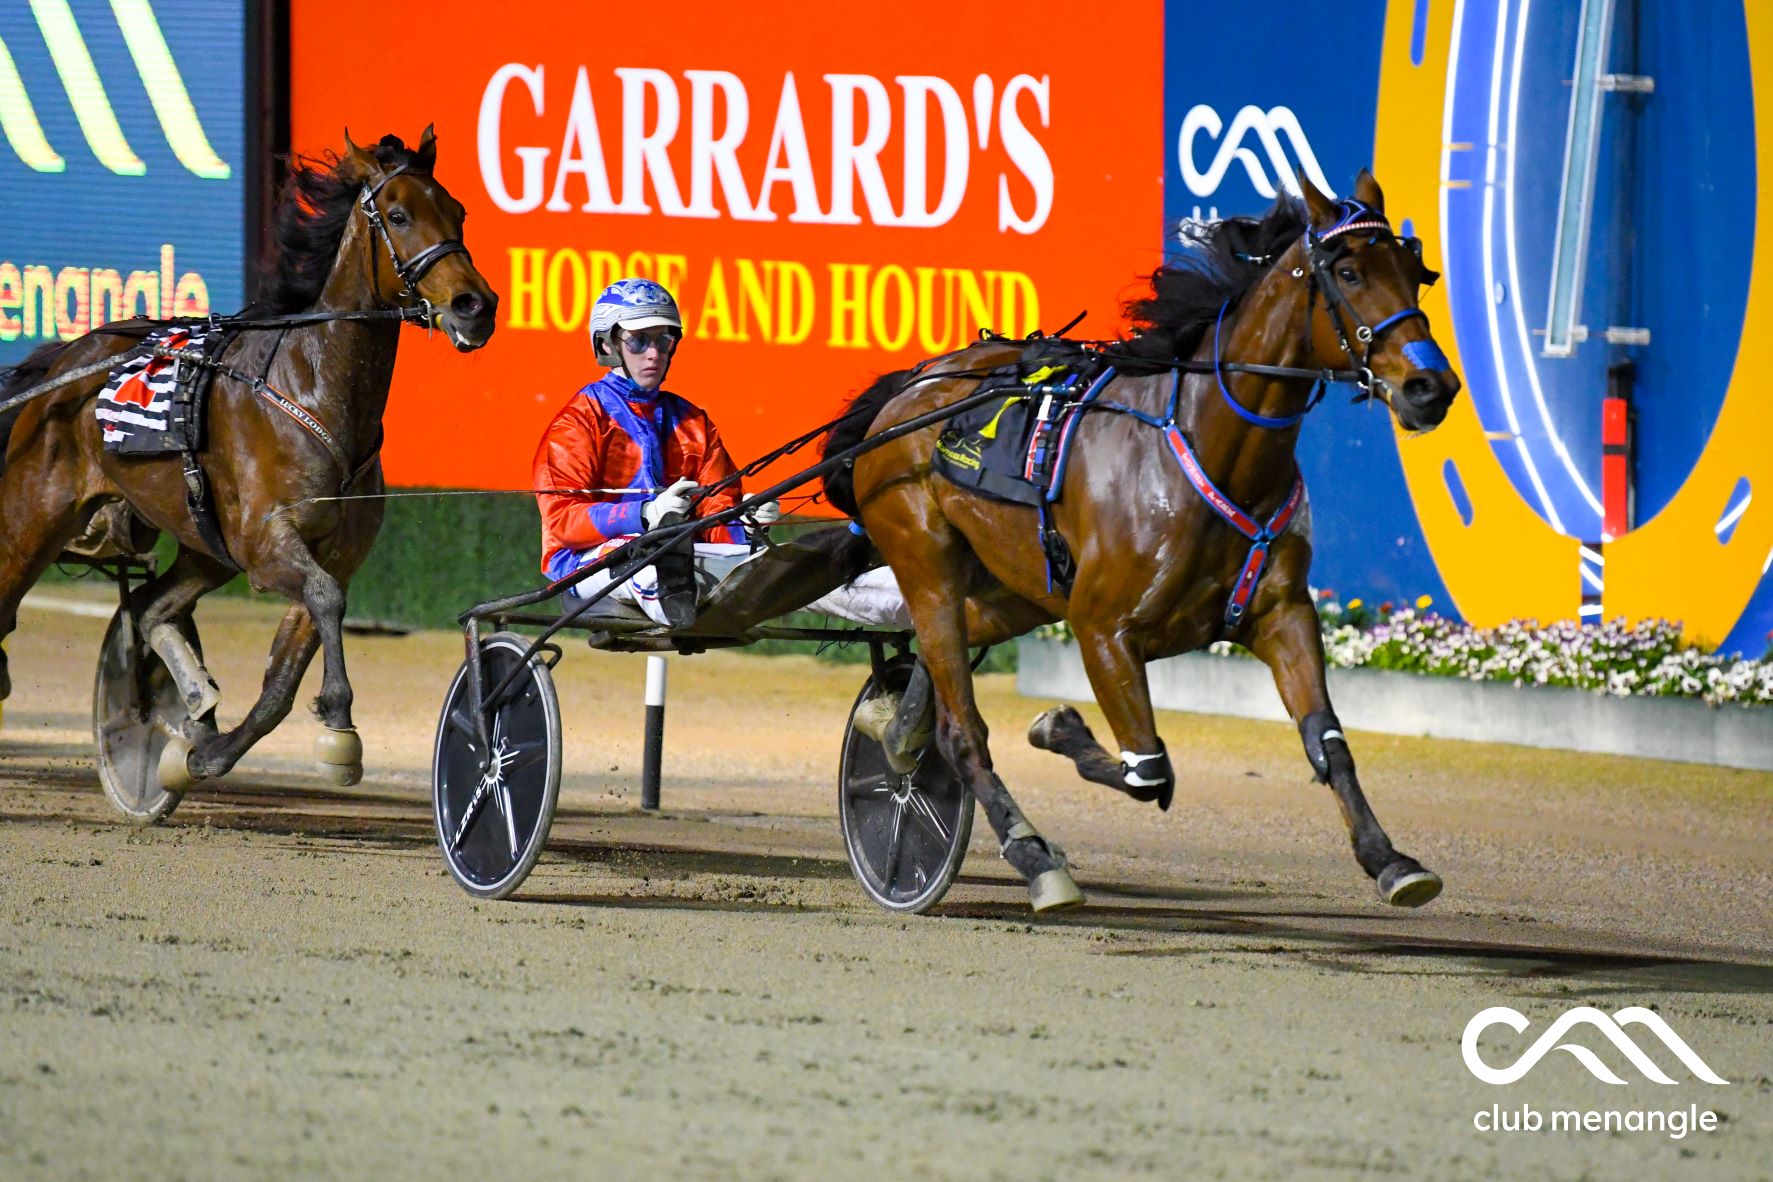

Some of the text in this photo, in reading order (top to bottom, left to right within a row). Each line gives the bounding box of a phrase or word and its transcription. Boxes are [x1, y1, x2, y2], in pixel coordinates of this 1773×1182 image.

[476, 62, 1056, 235] GARRARD'S
[694, 258, 817, 345] AND
[826, 263, 1041, 355] HOUND
[280, 398, 305, 419] LUCKY
